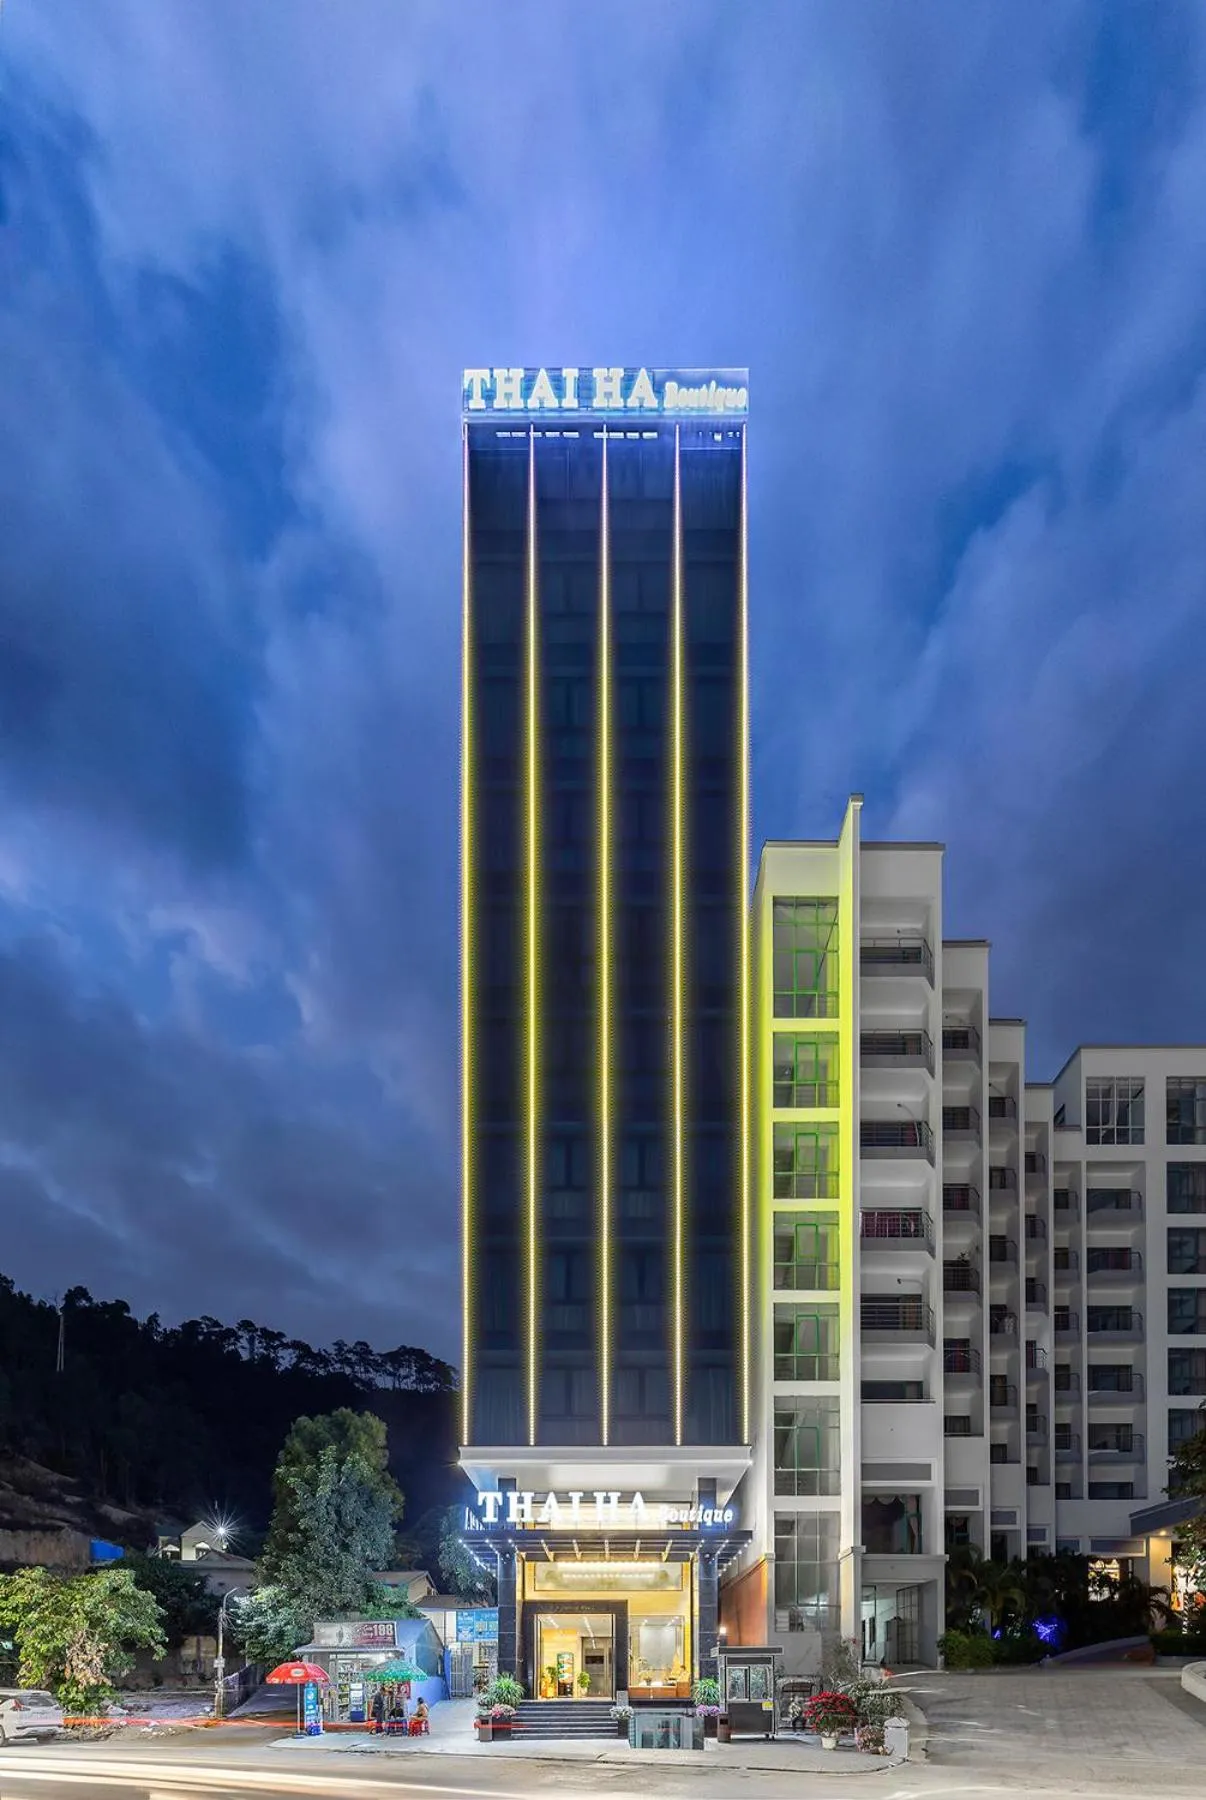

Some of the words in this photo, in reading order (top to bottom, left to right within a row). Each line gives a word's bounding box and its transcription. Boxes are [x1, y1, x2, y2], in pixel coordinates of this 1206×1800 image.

[463, 368, 578, 409] THAI
[592, 367, 658, 408] HA
[477, 1491, 583, 1523] THAI
[593, 1491, 650, 1523] HA
